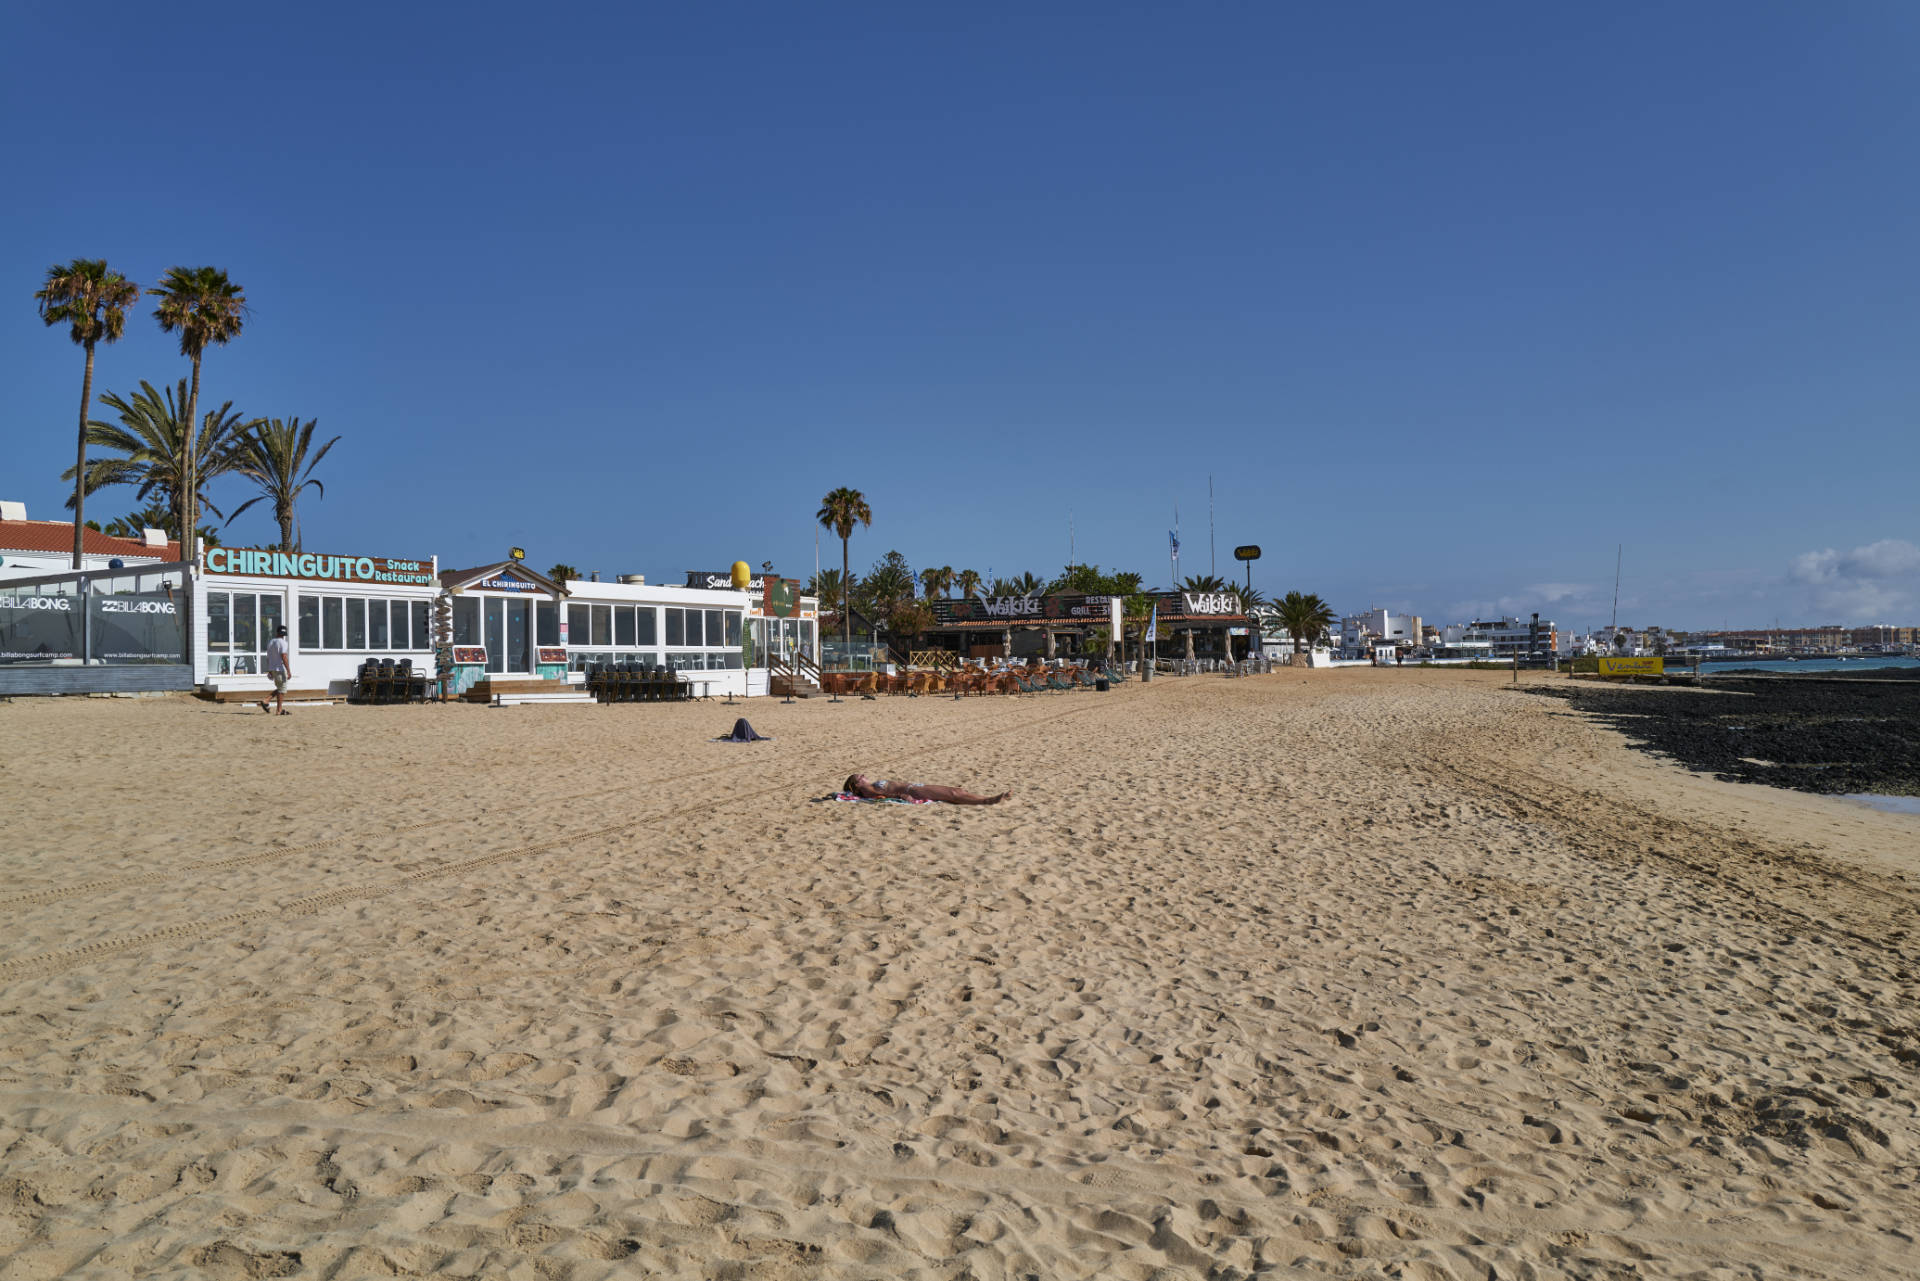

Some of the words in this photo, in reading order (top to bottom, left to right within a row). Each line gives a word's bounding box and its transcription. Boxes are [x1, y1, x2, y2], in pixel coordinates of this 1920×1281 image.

[207, 548, 375, 580] CHIRINGUITO
[387, 559, 420, 572] Snack
[375, 570, 433, 585] Restaurant
[492, 580, 536, 589] CHIRINGUITO
[706, 575, 732, 589] Sand
[748, 577, 765, 589] ach
[974, 591, 1041, 616] Waikiki
[1184, 592, 1233, 615] Waikiki
